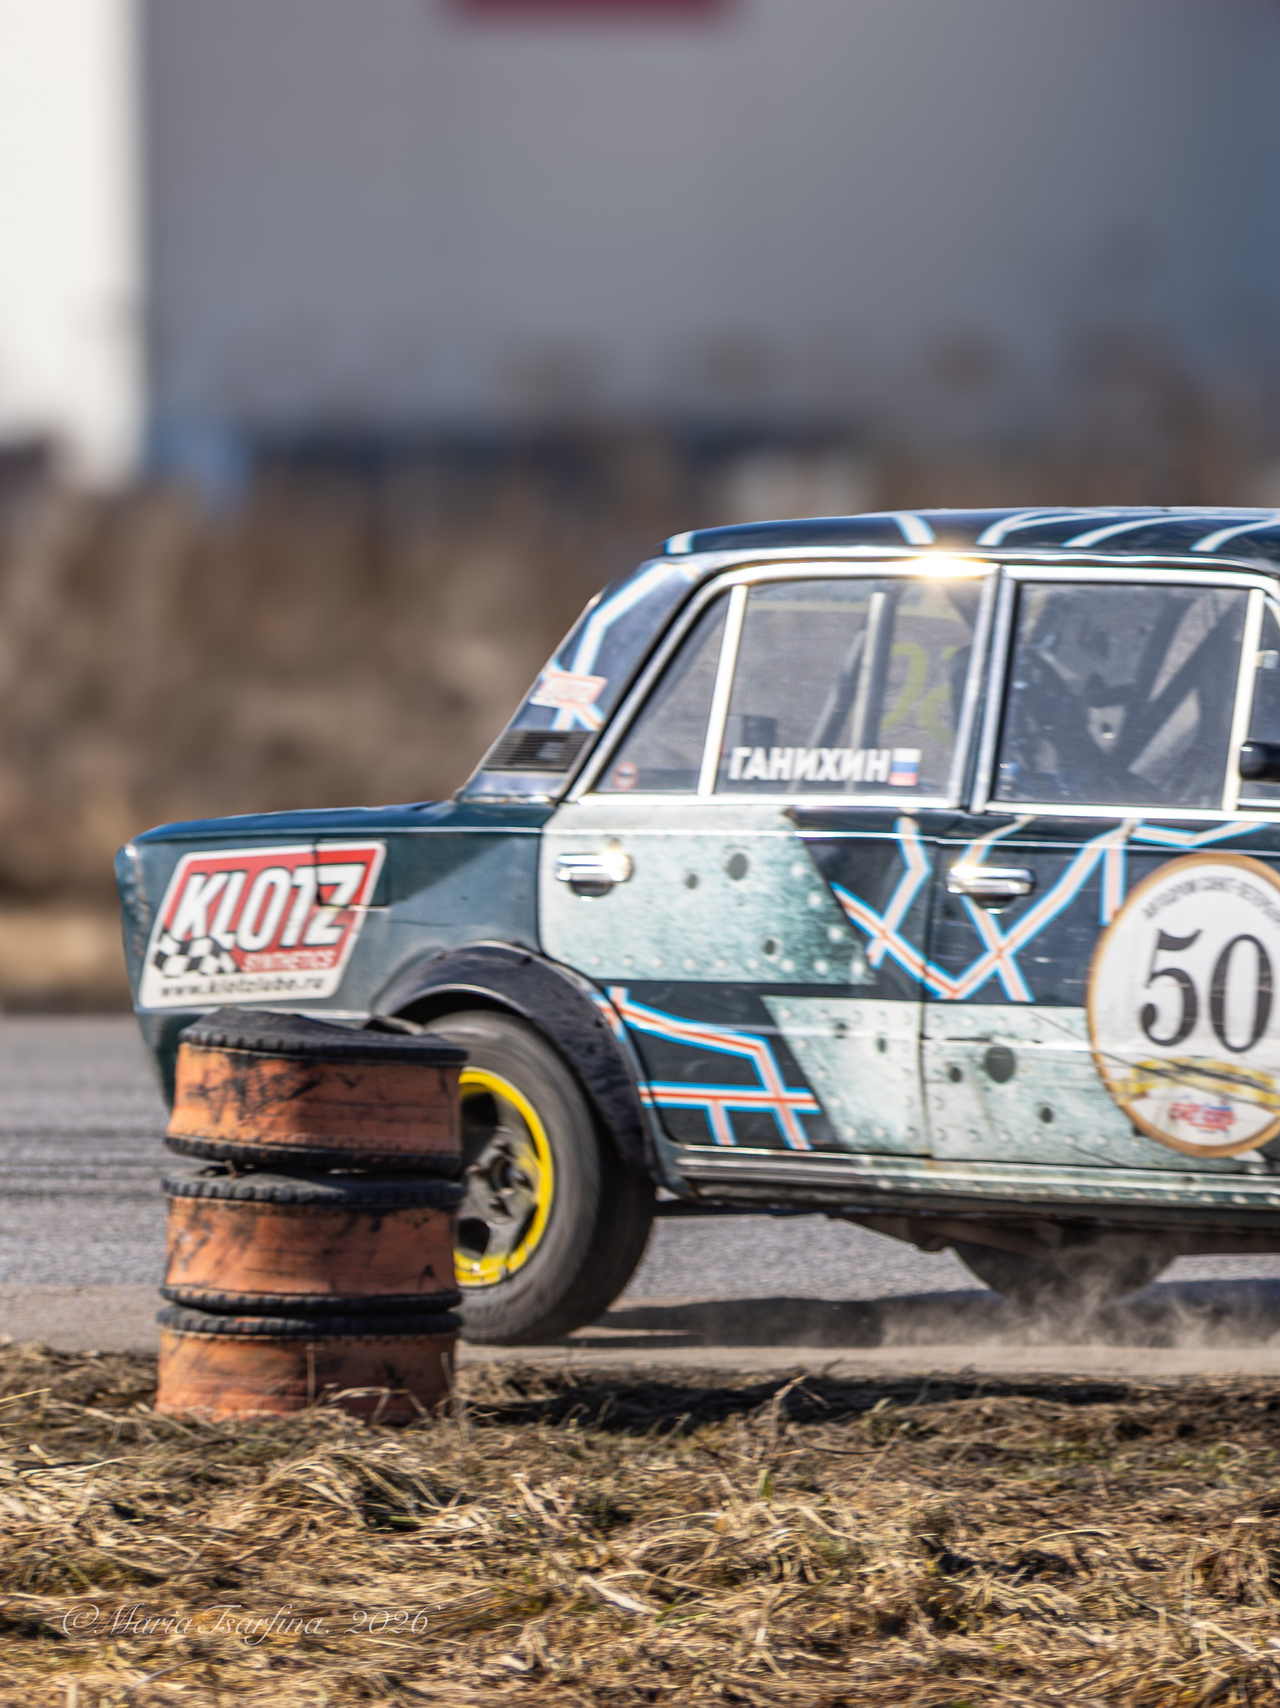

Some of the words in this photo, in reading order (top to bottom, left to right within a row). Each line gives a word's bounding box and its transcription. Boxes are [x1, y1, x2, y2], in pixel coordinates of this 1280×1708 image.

[728, 746, 891, 783] ГАНИХИН
[168, 862, 367, 952] KLOTZ
[1140, 928, 1275, 1053] 50
